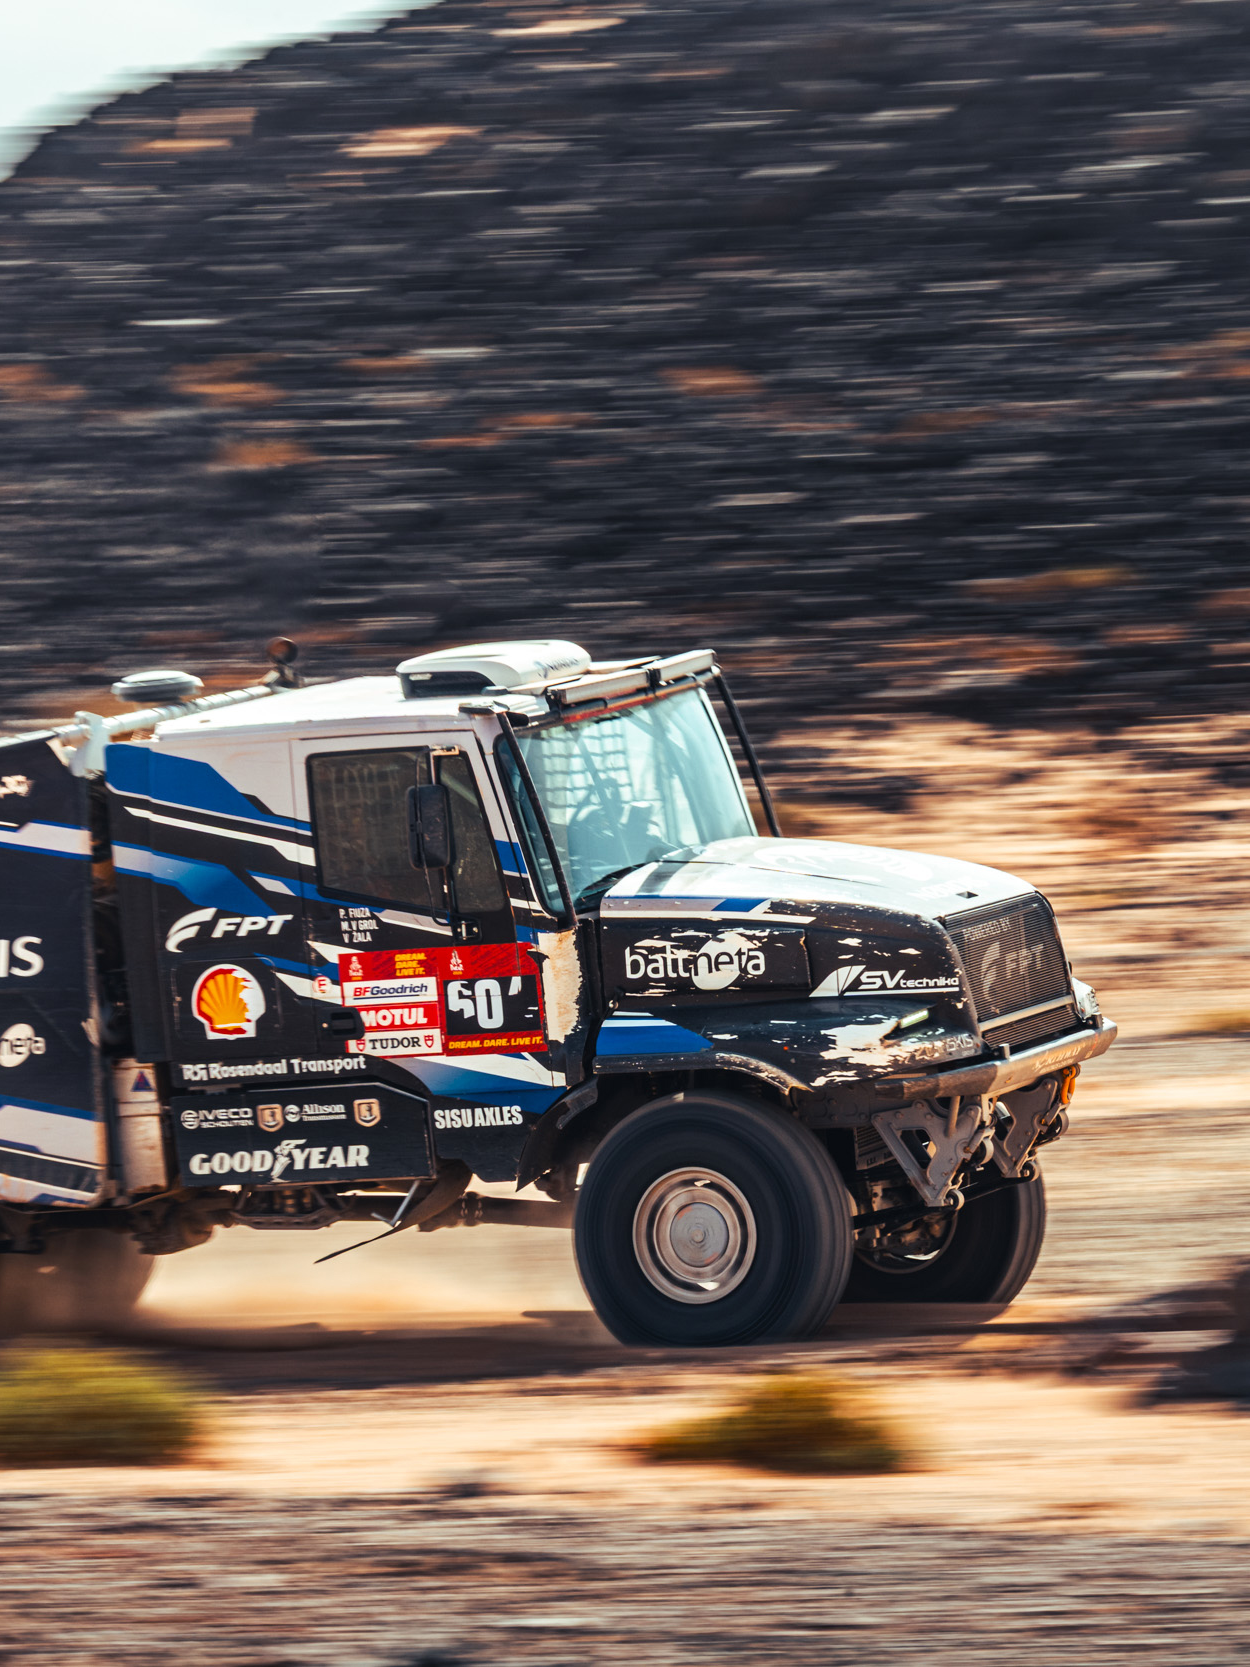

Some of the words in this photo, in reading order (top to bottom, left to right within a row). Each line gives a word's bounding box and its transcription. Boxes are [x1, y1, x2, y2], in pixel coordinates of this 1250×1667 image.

[210, 914, 294, 938] FPT
[353, 983, 428, 996] BFGoodrich
[360, 1007, 428, 1027] MOTUL
[369, 1037, 422, 1050] TUDOR
[448, 1040, 482, 1049] DREAM.
[483, 1038, 510, 1047] DARE.
[511, 1036, 531, 1046] LIVE
[209, 1059, 288, 1079] Rosendaal
[290, 1055, 366, 1074] Transport
[198, 1107, 253, 1120] IVECO
[301, 1104, 346, 1115] Allison
